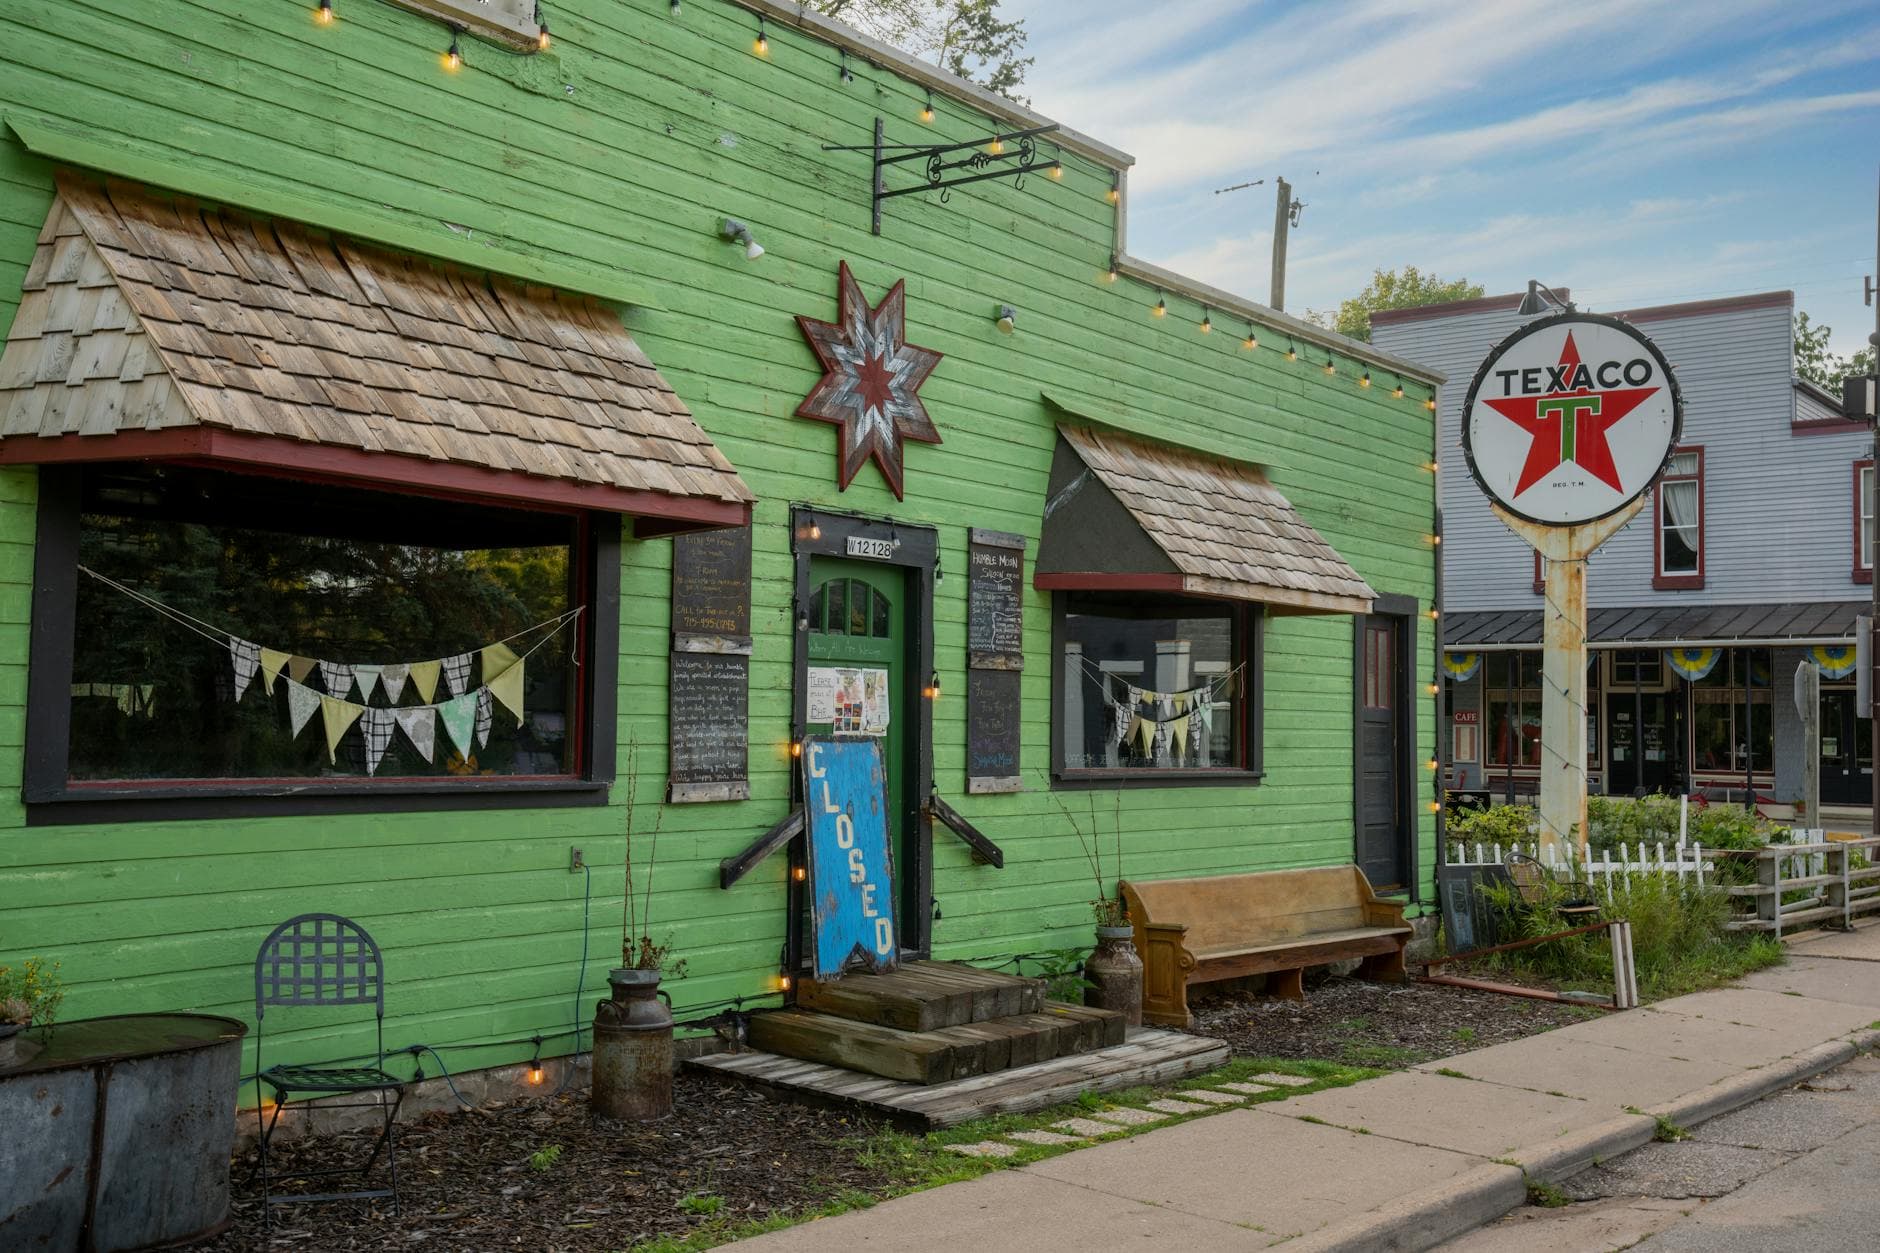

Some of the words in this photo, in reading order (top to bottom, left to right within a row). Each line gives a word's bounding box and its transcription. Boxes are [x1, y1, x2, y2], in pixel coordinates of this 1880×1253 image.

[1496, 359, 1653, 396] TEXACO
[1536, 395, 1602, 464] T
[847, 539, 891, 557] W12128
[972, 551, 997, 567] HUMBLE
[999, 554, 1018, 569] MOON
[1455, 712, 1477, 721] CAFE
[809, 745, 893, 955] CLOSED
